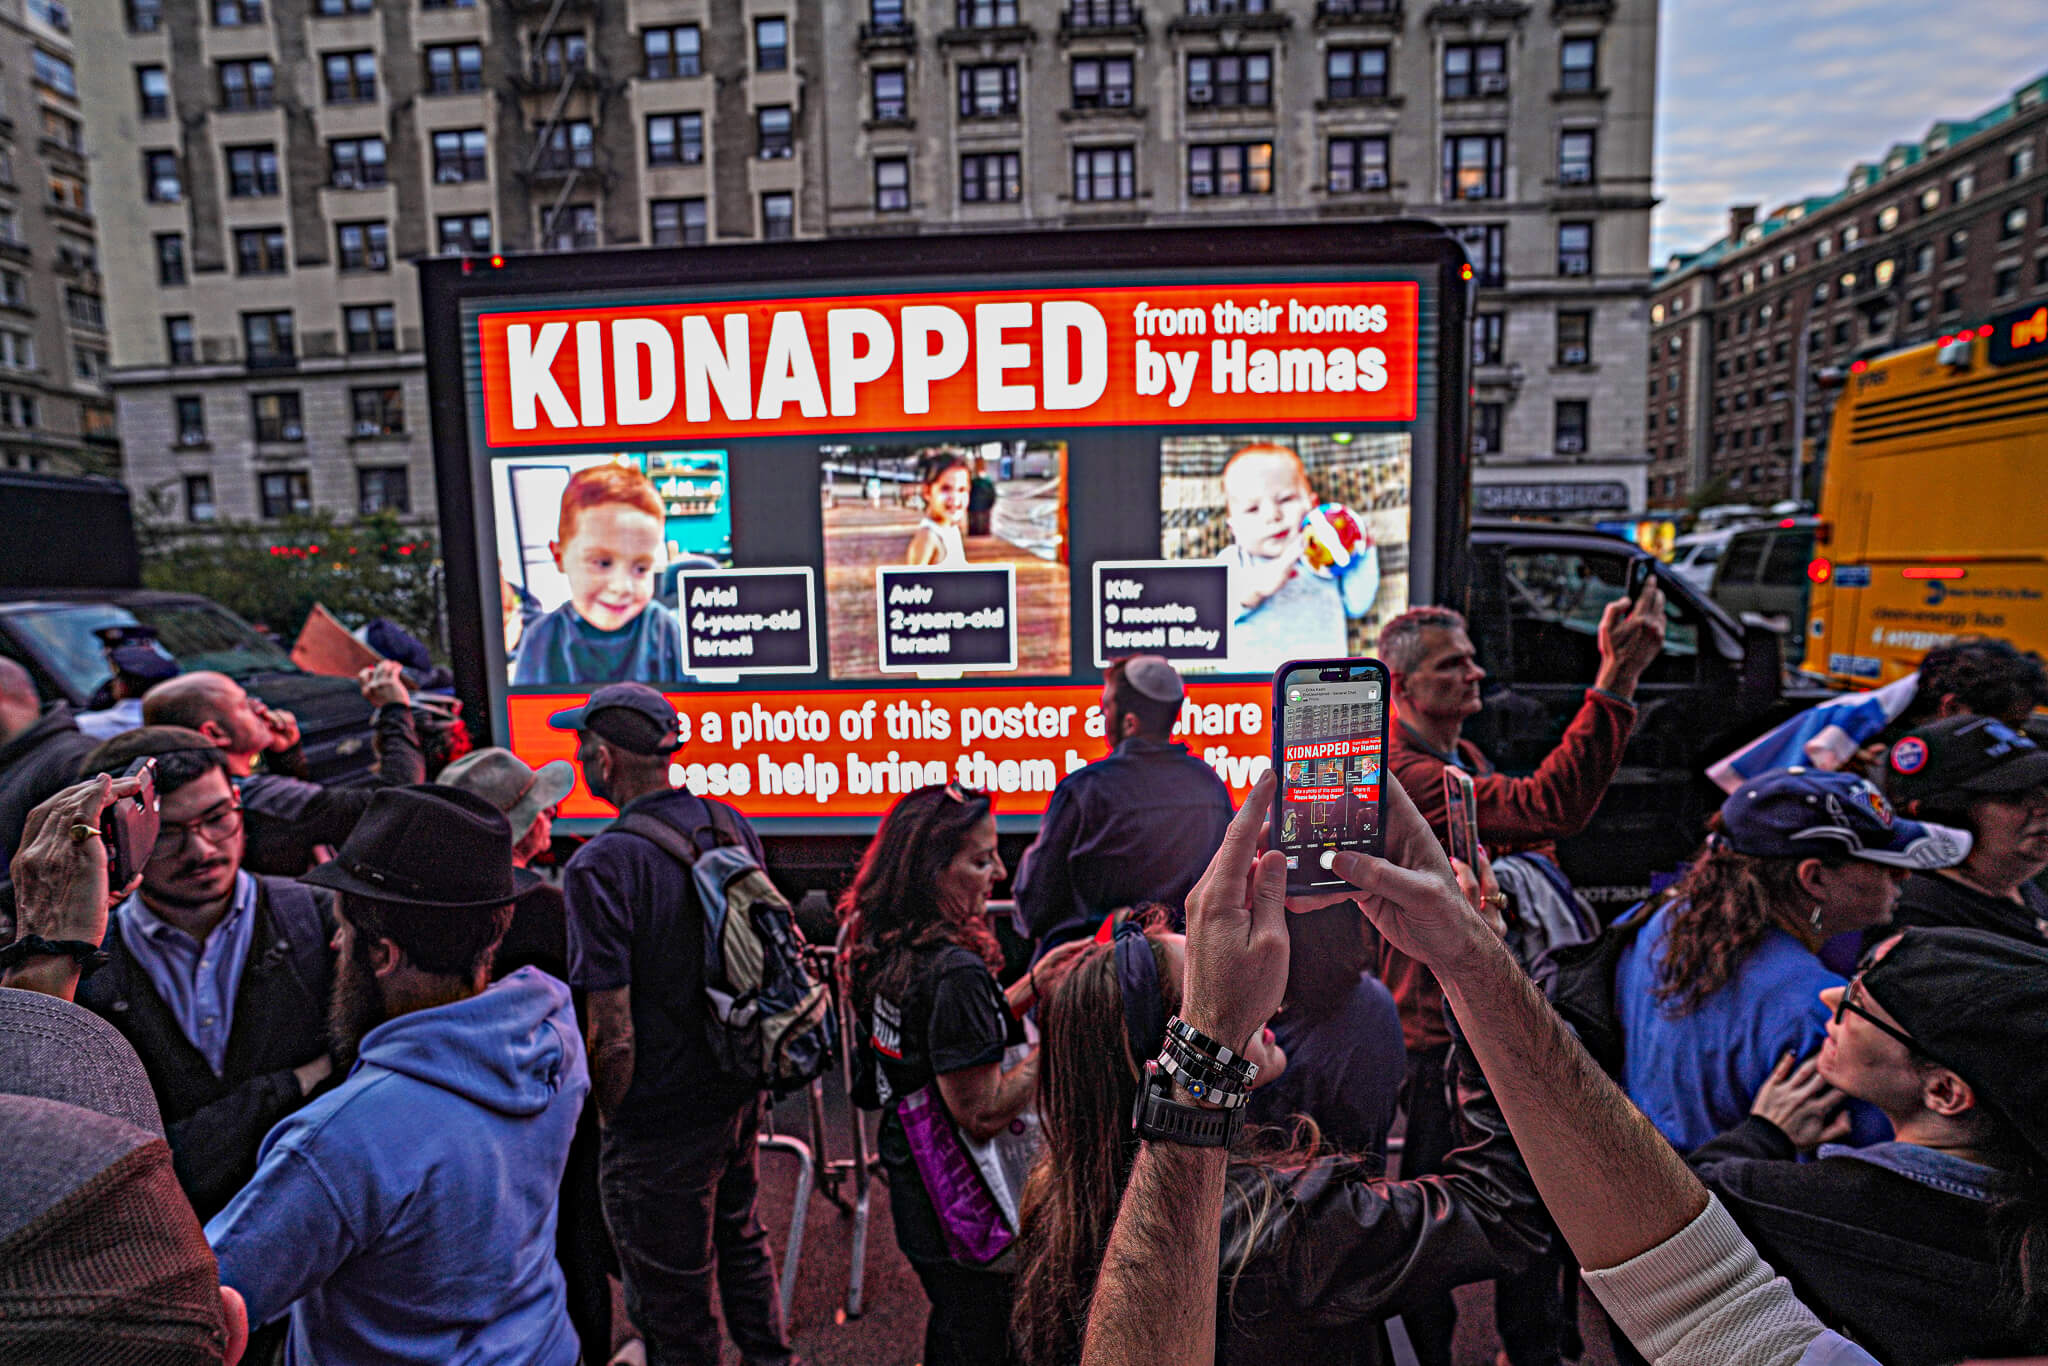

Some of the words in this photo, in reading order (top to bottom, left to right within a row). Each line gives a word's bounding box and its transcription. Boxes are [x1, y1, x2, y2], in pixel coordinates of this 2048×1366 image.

[1134, 301, 1206, 336] from
[1212, 299, 1283, 334] their
[1289, 298, 1388, 333] homes
[507, 301, 1108, 429] KIDNAPPED
[1136, 339, 1199, 407] by
[1212, 339, 1388, 393] Hamas
[690, 586, 738, 607] Ariel
[889, 584, 933, 605] Aviv
[691, 609, 801, 636] 4-years-old
[890, 607, 1005, 634] 2-years-old
[1122, 602, 1197, 623] months
[1168, 627, 1220, 650] Baby
[700, 711, 722, 742] a
[731, 702, 830, 750] photo
[839, 699, 876, 742] of
[883, 699, 951, 740] this
[961, 701, 1077, 747] poster
[1172, 697, 1262, 736] hare
[1286, 741, 1349, 760] KIDNAPPED
[668, 762, 751, 796] ease
[758, 753, 840, 803] help
[955, 751, 1057, 793] them
[1204, 746, 1271, 789] live
